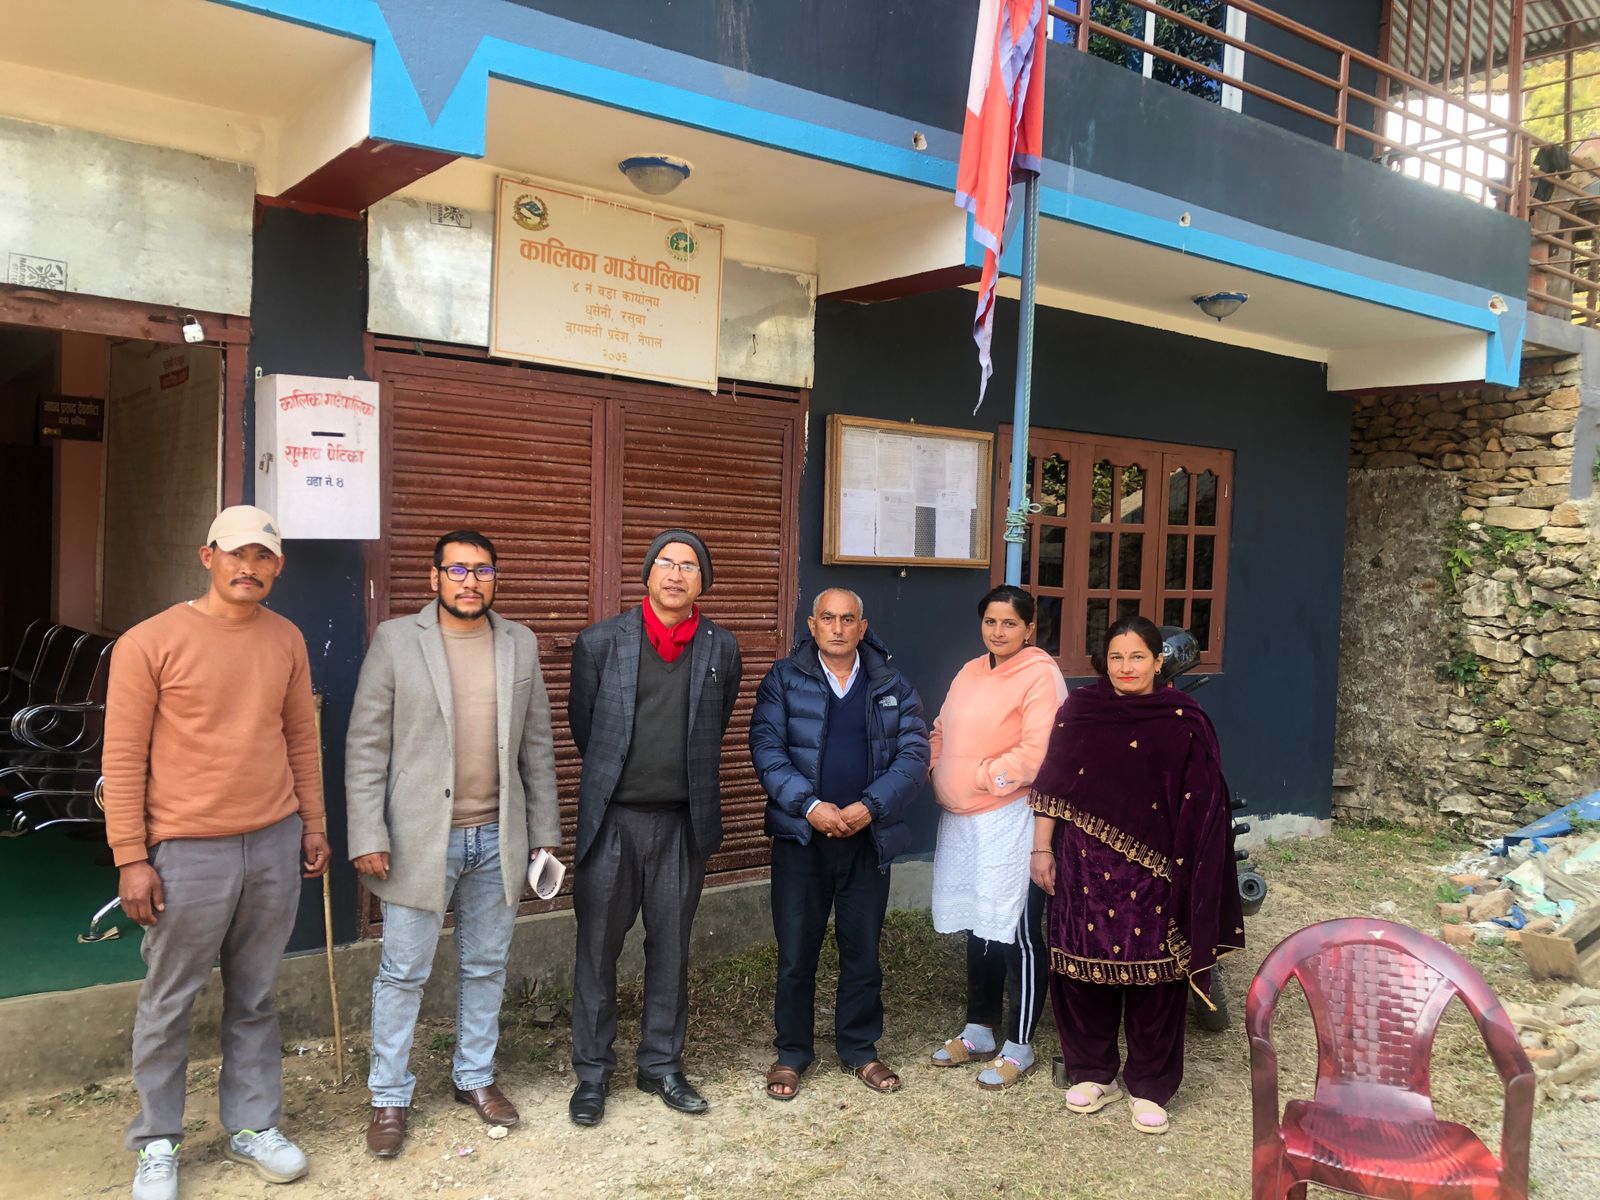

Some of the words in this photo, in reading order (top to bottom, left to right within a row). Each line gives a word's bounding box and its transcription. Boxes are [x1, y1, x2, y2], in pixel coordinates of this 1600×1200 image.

[520, 236, 599, 273] कालिका
[603, 255, 702, 294] गाउँपालिका
[571, 280, 580, 293] ४
[597, 285, 618, 300] वडा
[622, 288, 661, 308] कार्यालय
[565, 321, 603, 338] बागमती
[637, 331, 663, 349] नेपाल
[279, 389, 323, 411] कालिका
[327, 443, 365, 464] पेटिका
[306, 476, 323, 487] वडा
[336, 477, 345, 488] ४
